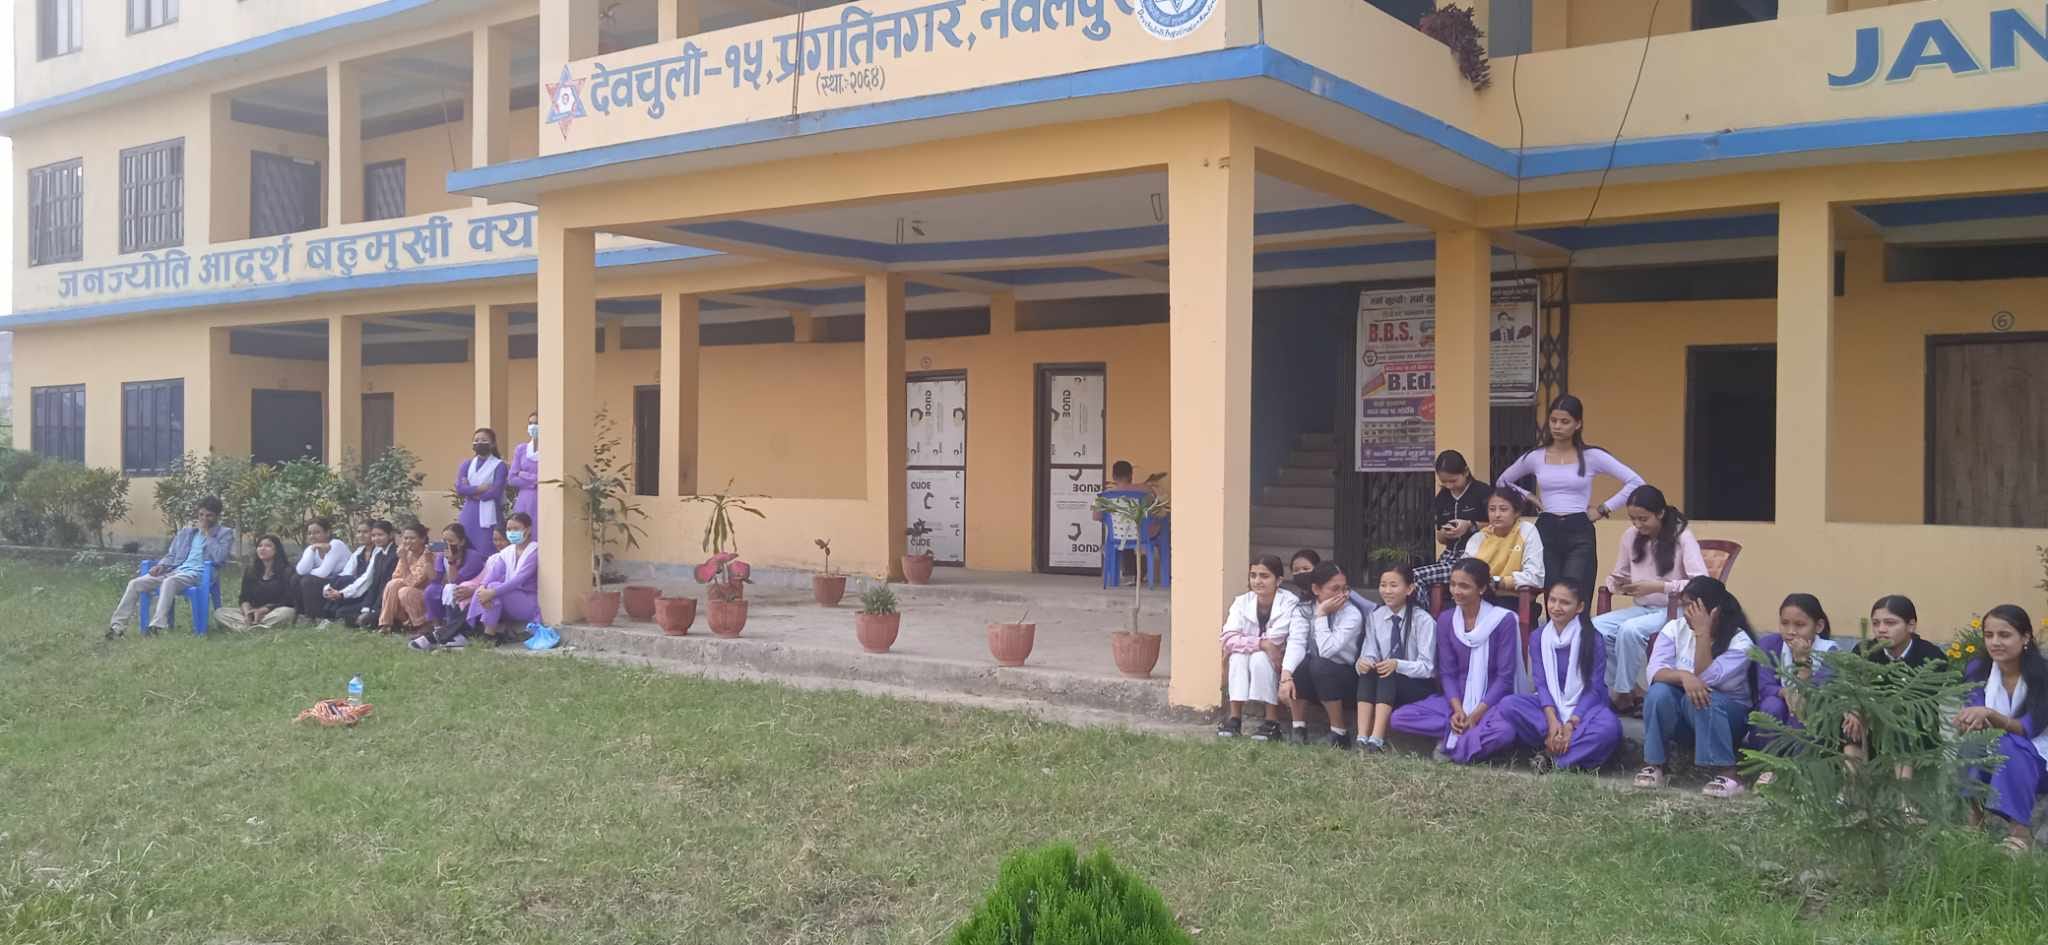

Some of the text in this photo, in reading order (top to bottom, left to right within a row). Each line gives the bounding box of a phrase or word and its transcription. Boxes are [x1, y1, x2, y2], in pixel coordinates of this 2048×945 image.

[1827, 4, 2048, 88] JAN
[57, 249, 191, 298] जनज्योति
[199, 236, 293, 284] आदर्श
[305, 215, 453, 275] बहुमुखी
[1368, 321, 1414, 343] B.B.S.
[1996, 314, 2008, 328] 6
[1387, 372, 1436, 392] B.Ed.
